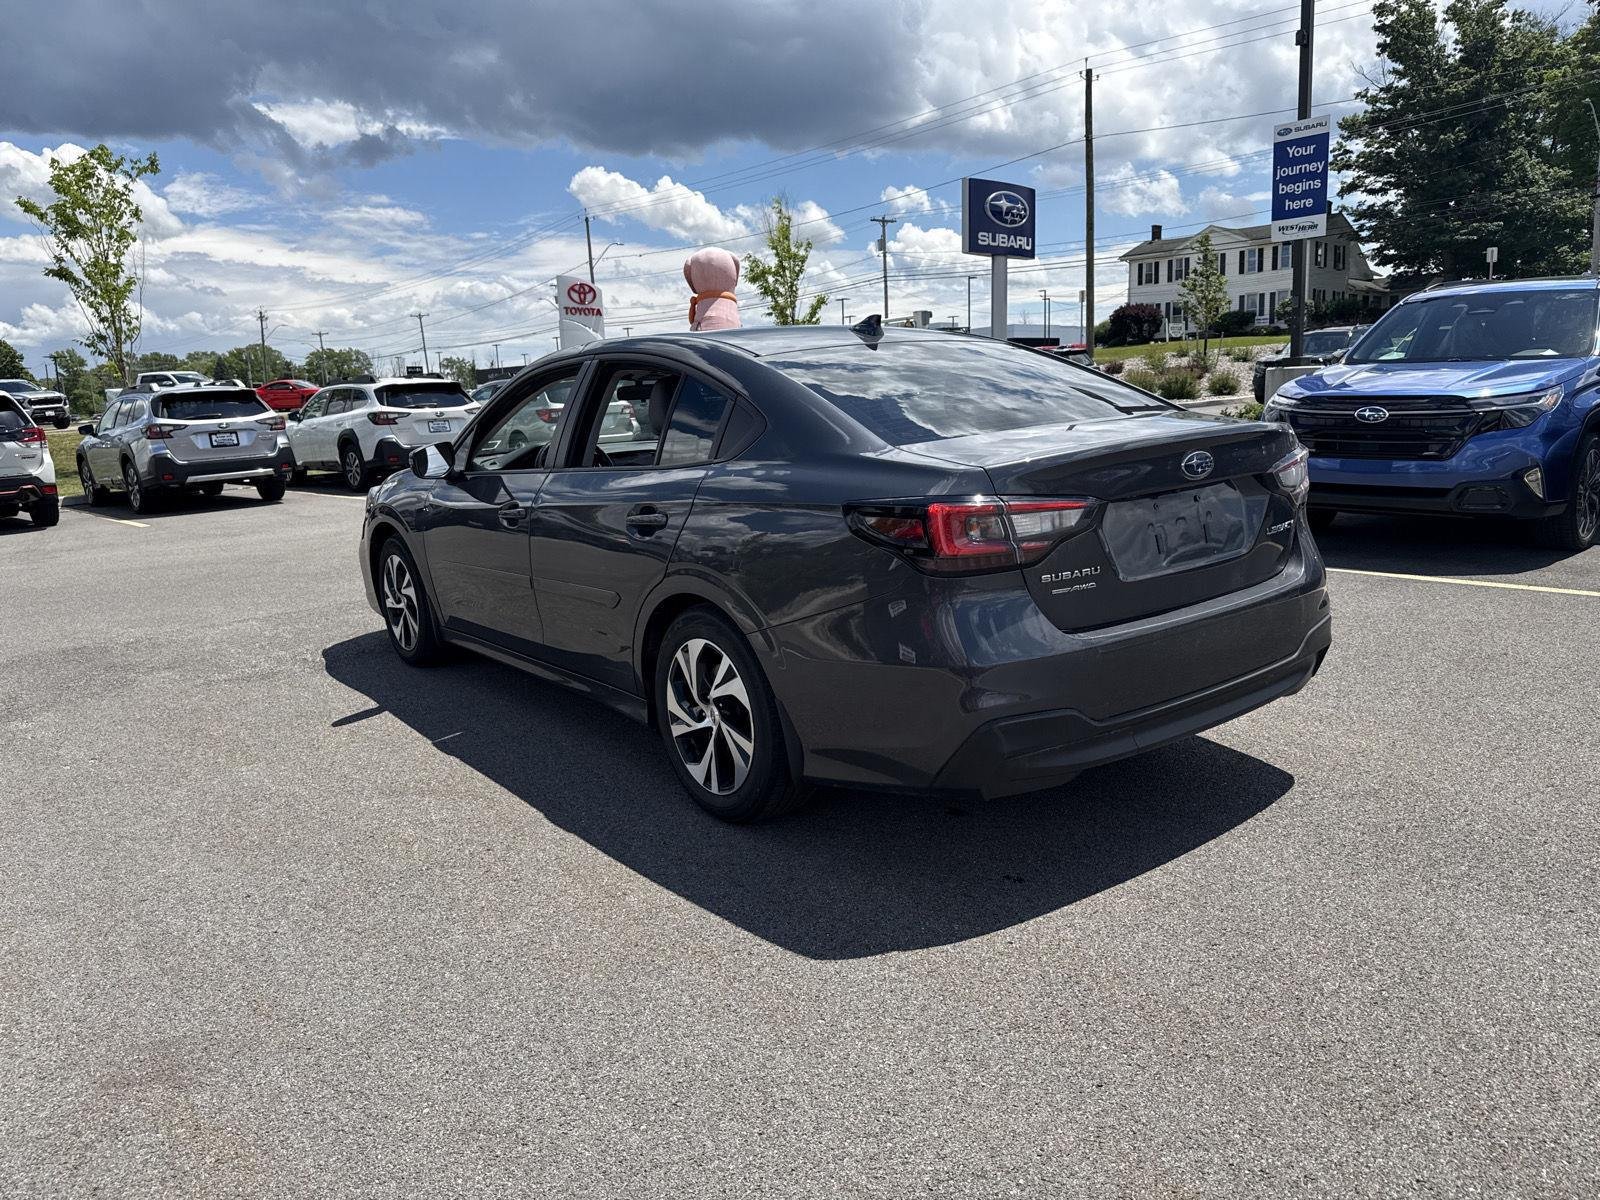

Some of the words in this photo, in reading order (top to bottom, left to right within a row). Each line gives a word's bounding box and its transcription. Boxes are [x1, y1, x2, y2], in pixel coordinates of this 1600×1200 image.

[1294, 121, 1327, 133] SUBARU
[1286, 144, 1316, 158] Your
[1275, 160, 1325, 180] journey
[1278, 178, 1322, 195] begins
[1285, 197, 1314, 211] here
[977, 231, 1032, 251] SUBARU
[563, 306, 603, 317] TOYOTA
[1041, 566, 1101, 583] SUBARU
